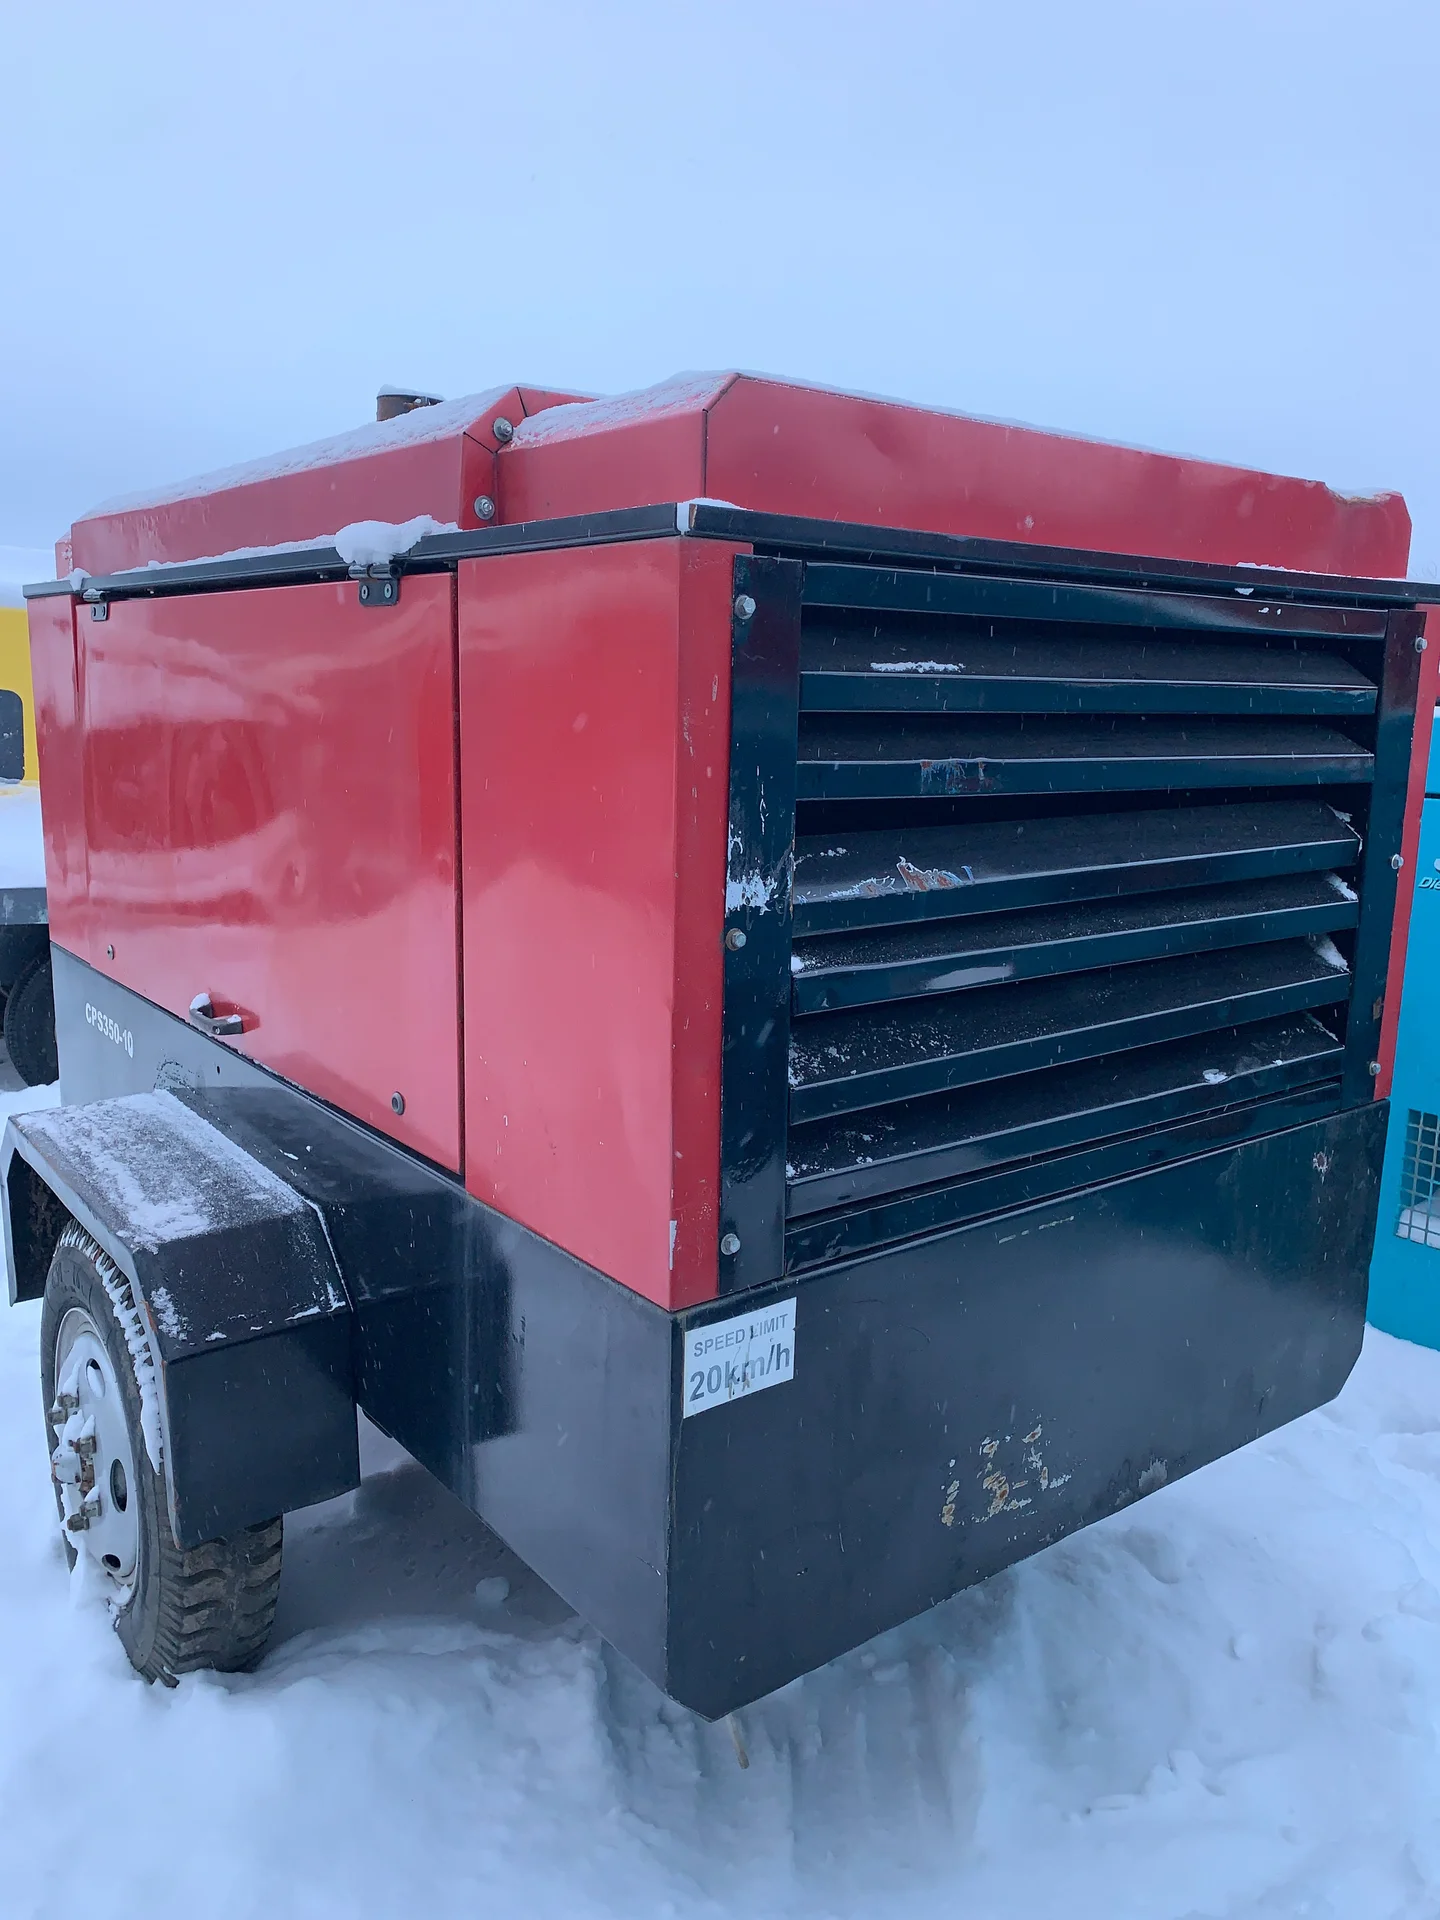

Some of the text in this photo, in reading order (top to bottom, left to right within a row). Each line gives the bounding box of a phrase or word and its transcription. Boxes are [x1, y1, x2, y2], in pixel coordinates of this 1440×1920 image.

[85, 1002, 133, 1059] CPS350-10
[693, 1313, 789, 1358] SPEED LIMIT
[689, 1343, 790, 1402] 20km/h
